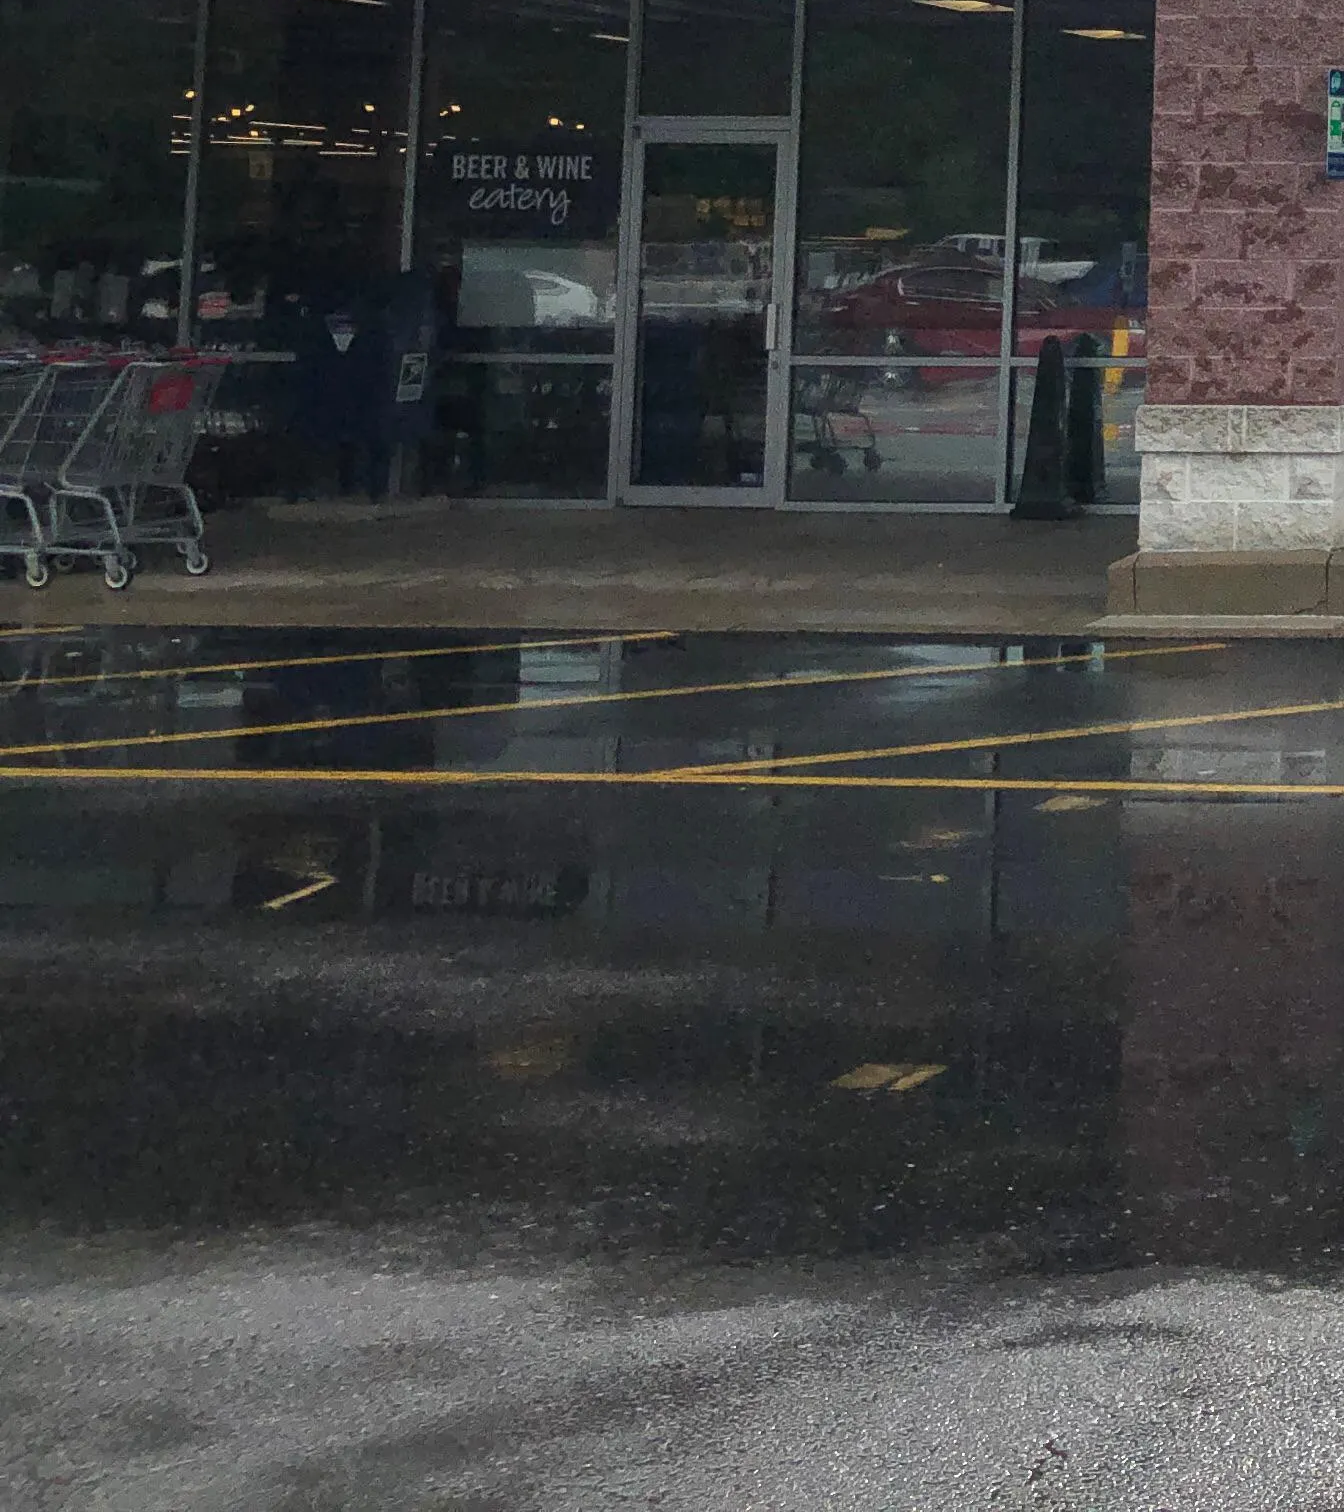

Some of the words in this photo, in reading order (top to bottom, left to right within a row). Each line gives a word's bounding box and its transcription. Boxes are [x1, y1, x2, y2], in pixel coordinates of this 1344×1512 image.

[451, 155, 508, 180] BEER
[514, 155, 530, 180] &
[537, 155, 593, 180] WINE
[468, 183, 572, 226] eatery
